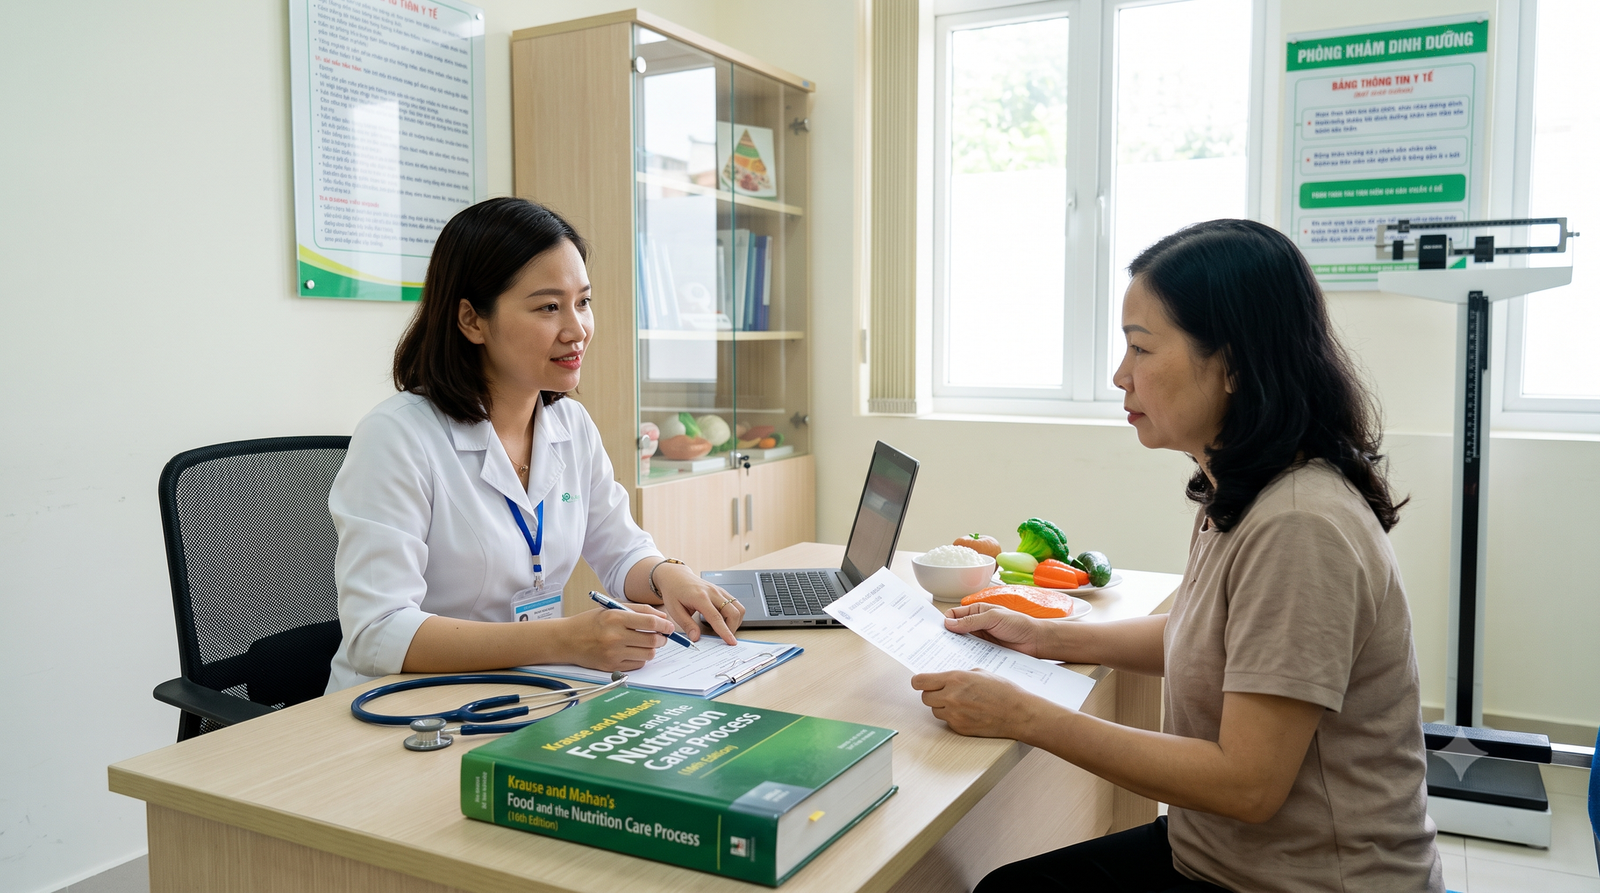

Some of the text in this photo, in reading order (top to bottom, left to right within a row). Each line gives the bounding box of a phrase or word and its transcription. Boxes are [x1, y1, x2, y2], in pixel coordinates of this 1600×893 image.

[421, 5, 427, 15] Y
[1297, 30, 1474, 64] PHÒNG KHÁM DINH DƯỠNG
[1395, 74, 1410, 86] TIN
[1413, 73, 1419, 83] Y
[1422, 69, 1434, 82] TẾ
[541, 699, 661, 751] Krause and Mahan's
[566, 705, 693, 759] Food and the
[606, 710, 727, 764] Nutrition
[644, 712, 761, 770] Care Process
[508, 774, 544, 795] Krause
[546, 785, 567, 799] and
[569, 787, 615, 809] Mahan's
[507, 811, 559, 832] (16th Edition)
[508, 792, 700, 847] Food and the Nutrition Care Process
